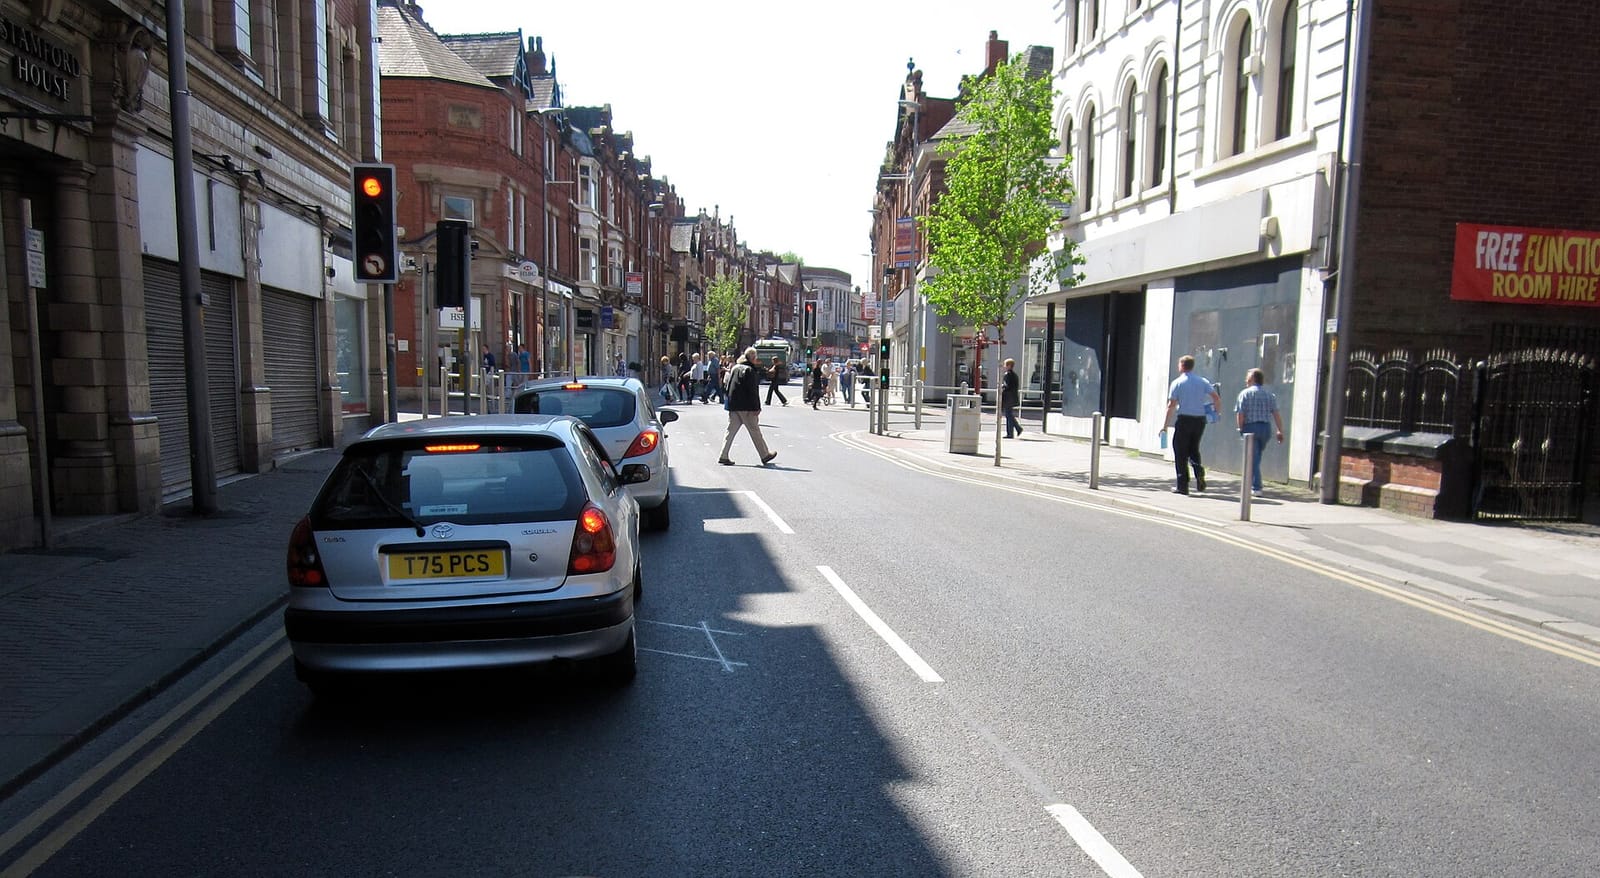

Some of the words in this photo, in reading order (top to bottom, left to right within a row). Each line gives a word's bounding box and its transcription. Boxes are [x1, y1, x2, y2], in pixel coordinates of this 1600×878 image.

[0, 20, 81, 78] STAMFORD
[18, 56, 72, 102] HOUSE
[1475, 231, 1523, 271] FREE
[1492, 272, 1552, 298] ROOM
[1557, 275, 1599, 300] HIRE
[403, 556, 443, 575] T75
[449, 554, 489, 573] PCS
